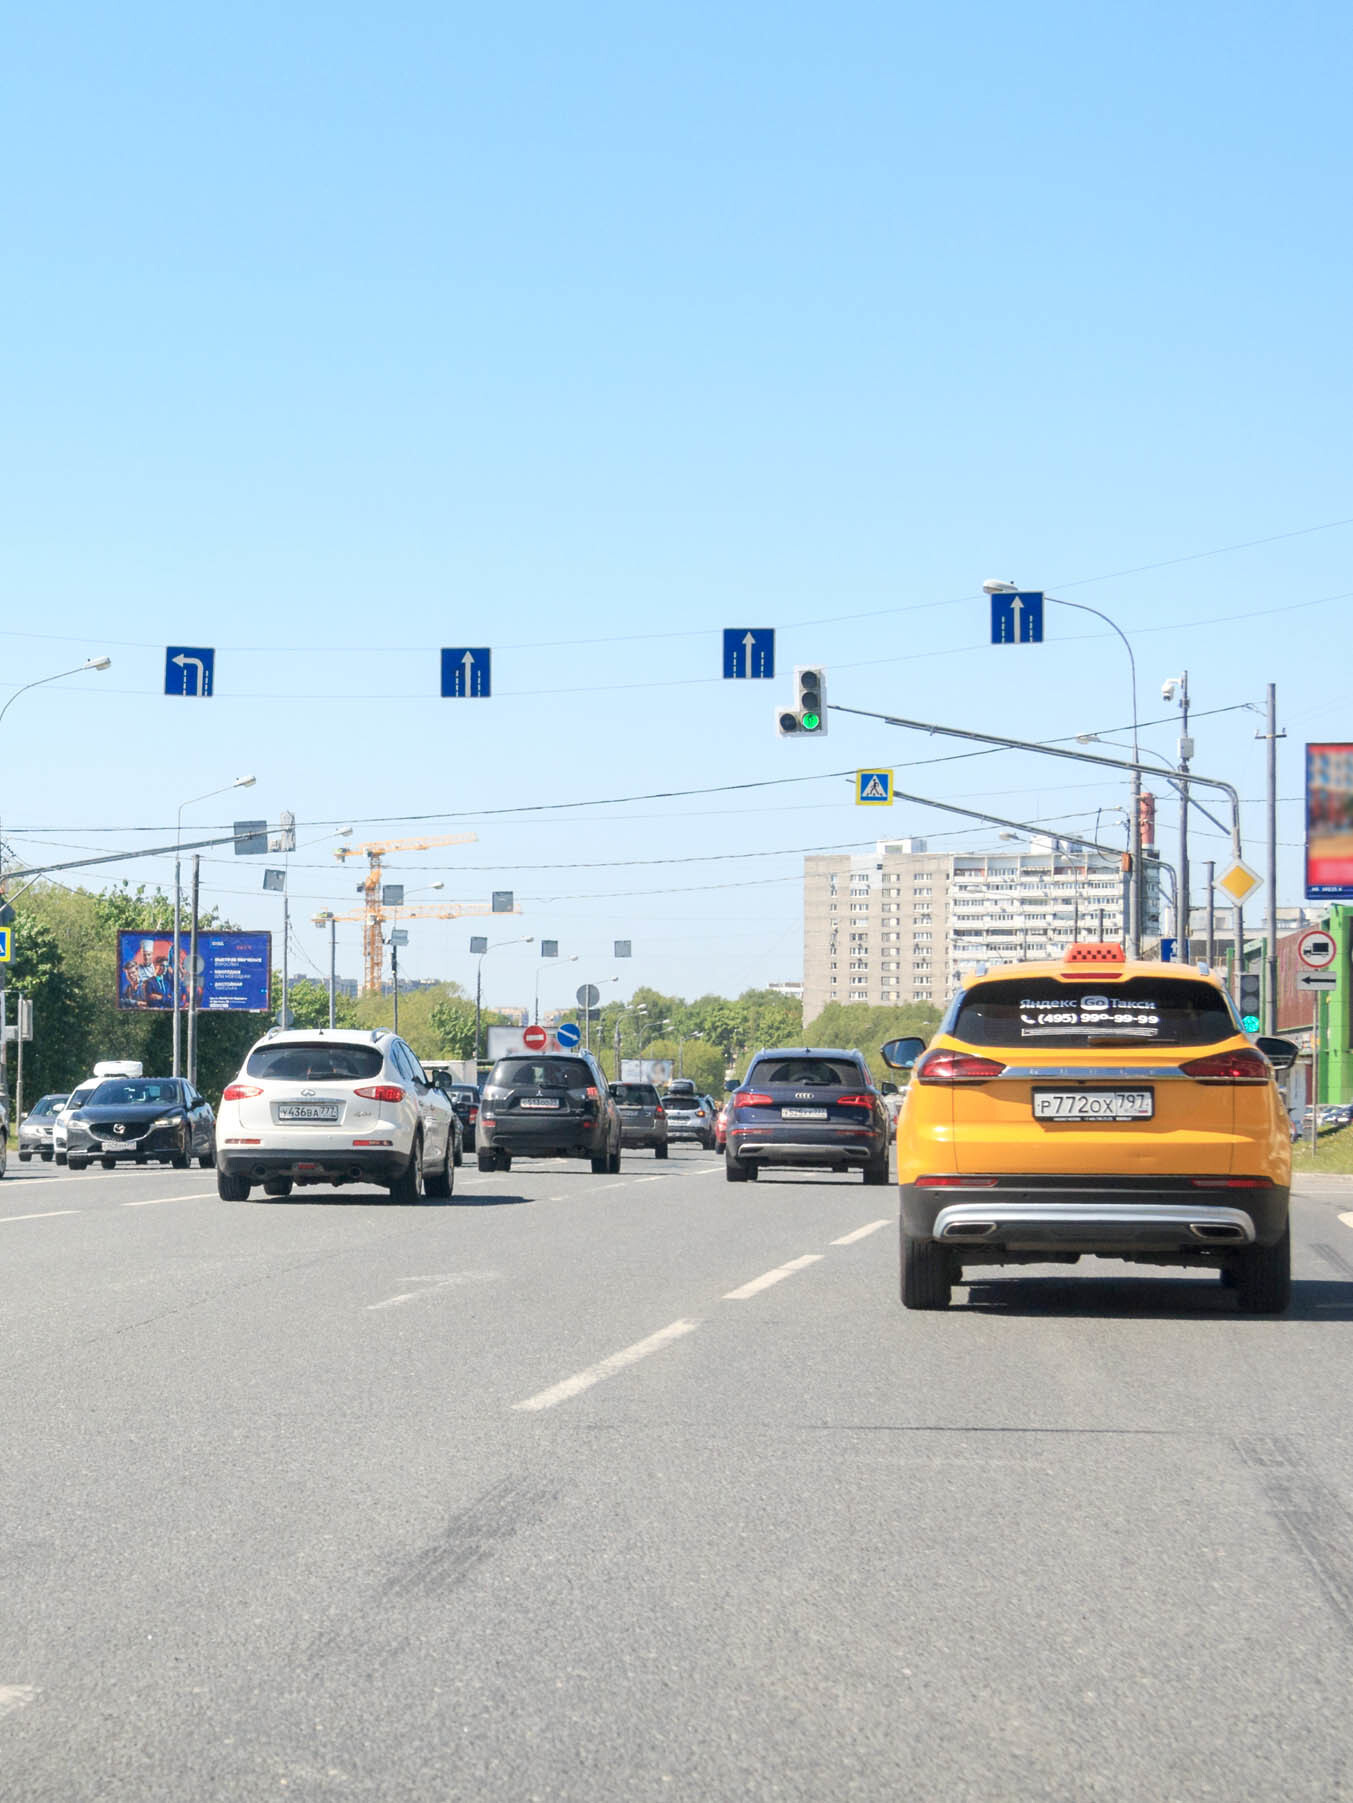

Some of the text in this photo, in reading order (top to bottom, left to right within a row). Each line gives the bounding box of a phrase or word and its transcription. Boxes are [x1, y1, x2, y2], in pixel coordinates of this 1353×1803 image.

[1019, 998, 1078, 1010] Яндекс
[1110, 998, 1157, 1010] Такси
[1037, 1013, 1078, 1025] (495)
